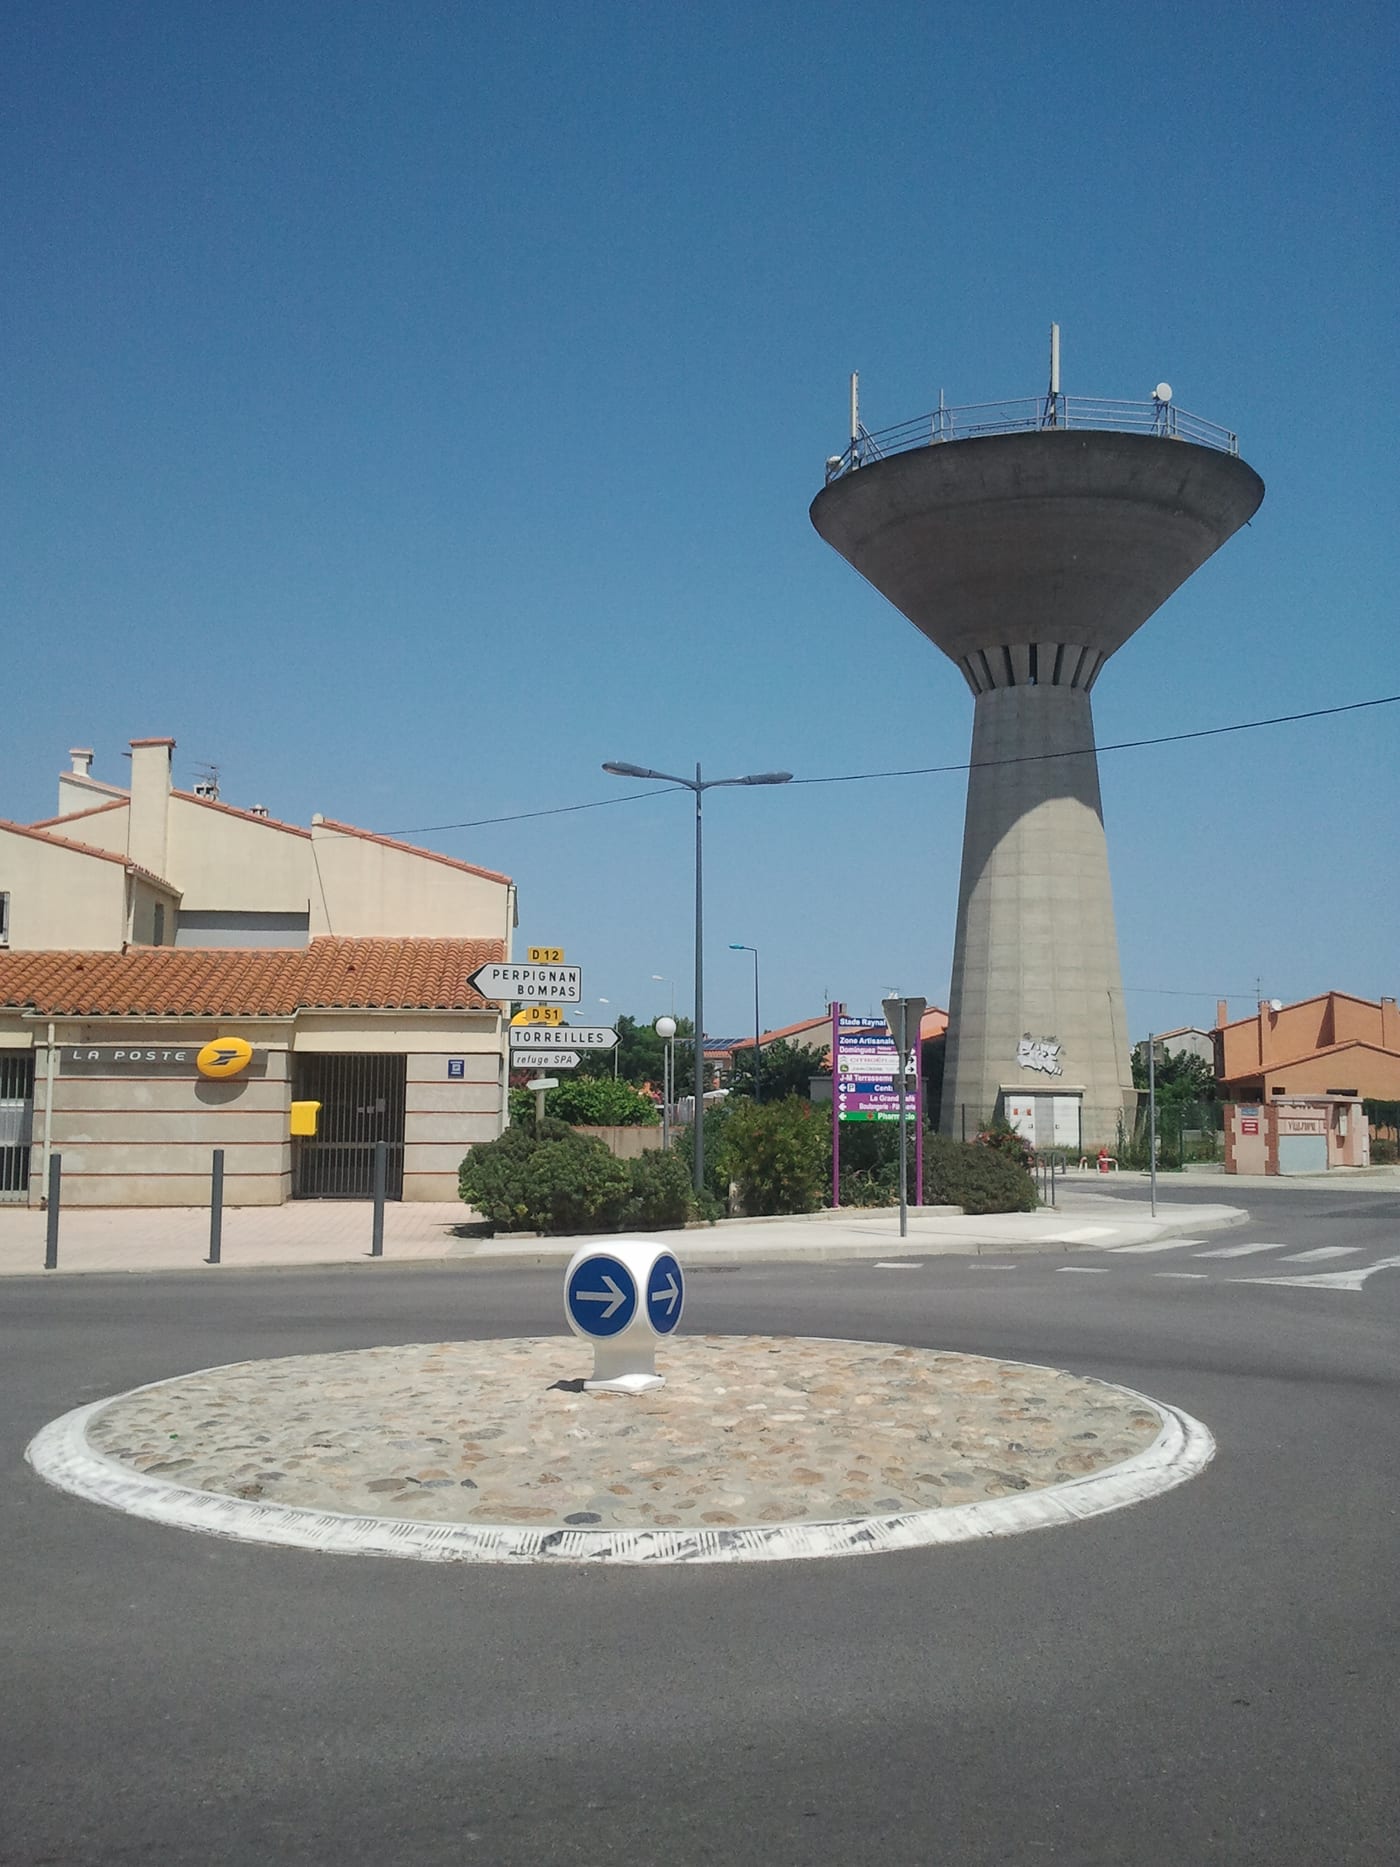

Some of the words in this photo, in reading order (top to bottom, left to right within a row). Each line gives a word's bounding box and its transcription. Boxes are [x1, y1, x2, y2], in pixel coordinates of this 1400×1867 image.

[532, 950, 540, 960] D
[544, 950, 559, 961] 12
[492, 969, 576, 983] PERPIGNAN
[517, 985, 576, 997] BOMPAS
[532, 1009, 540, 1019] D
[544, 1009, 558, 1020] 51
[515, 1031, 604, 1043] TORREILLES
[72, 1050, 100, 1061] LA
[113, 1051, 187, 1062] POSTE
[516, 1055, 549, 1066] refuge
[554, 1055, 573, 1064] SPA
